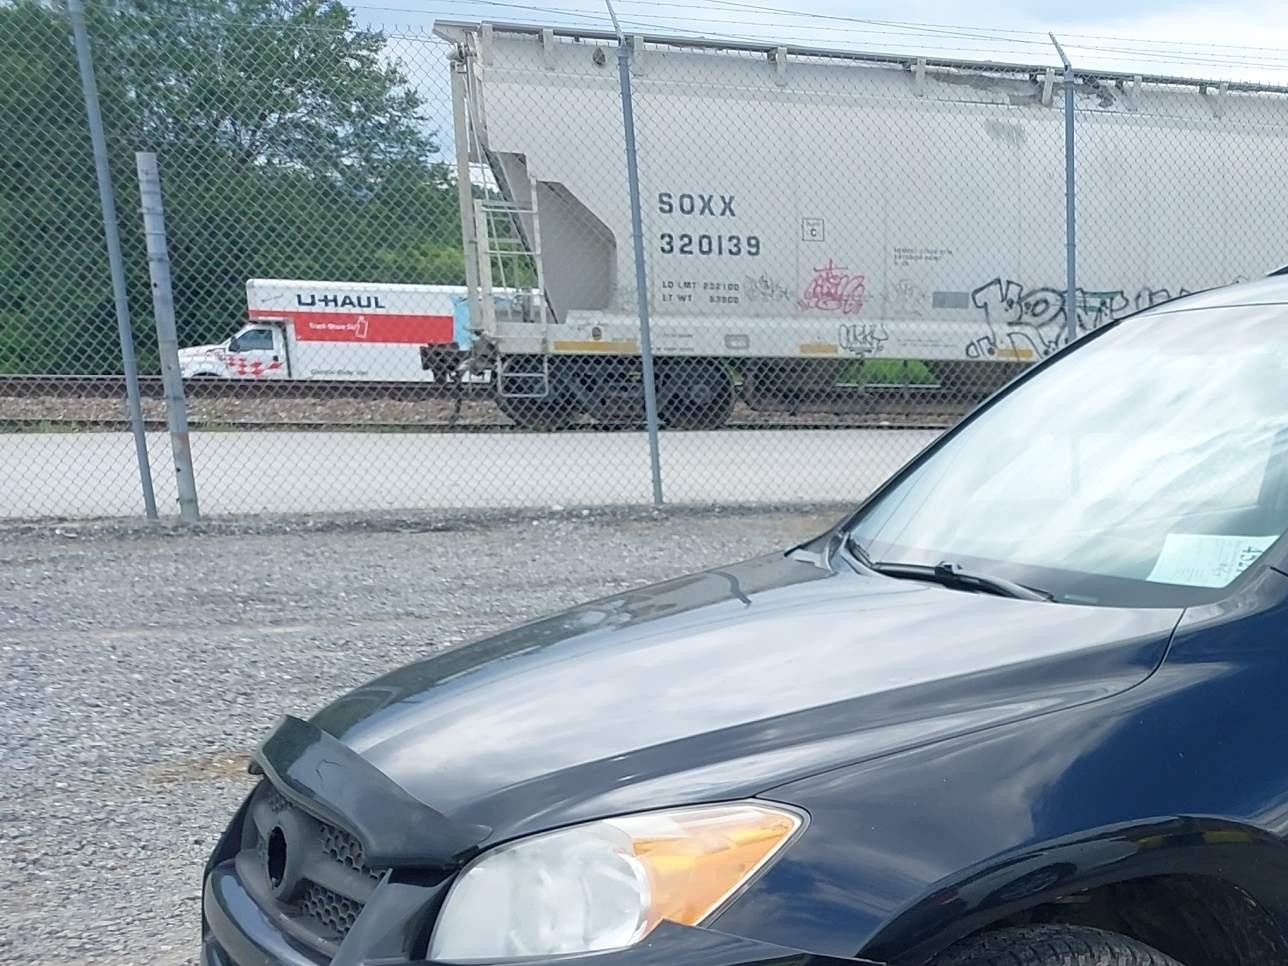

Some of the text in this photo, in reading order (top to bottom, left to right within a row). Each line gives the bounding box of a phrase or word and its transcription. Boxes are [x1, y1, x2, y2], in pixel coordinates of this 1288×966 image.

[658, 192, 736, 216] SOXX
[660, 233, 760, 256] 320139
[296, 294, 386, 308] U-HAUL
